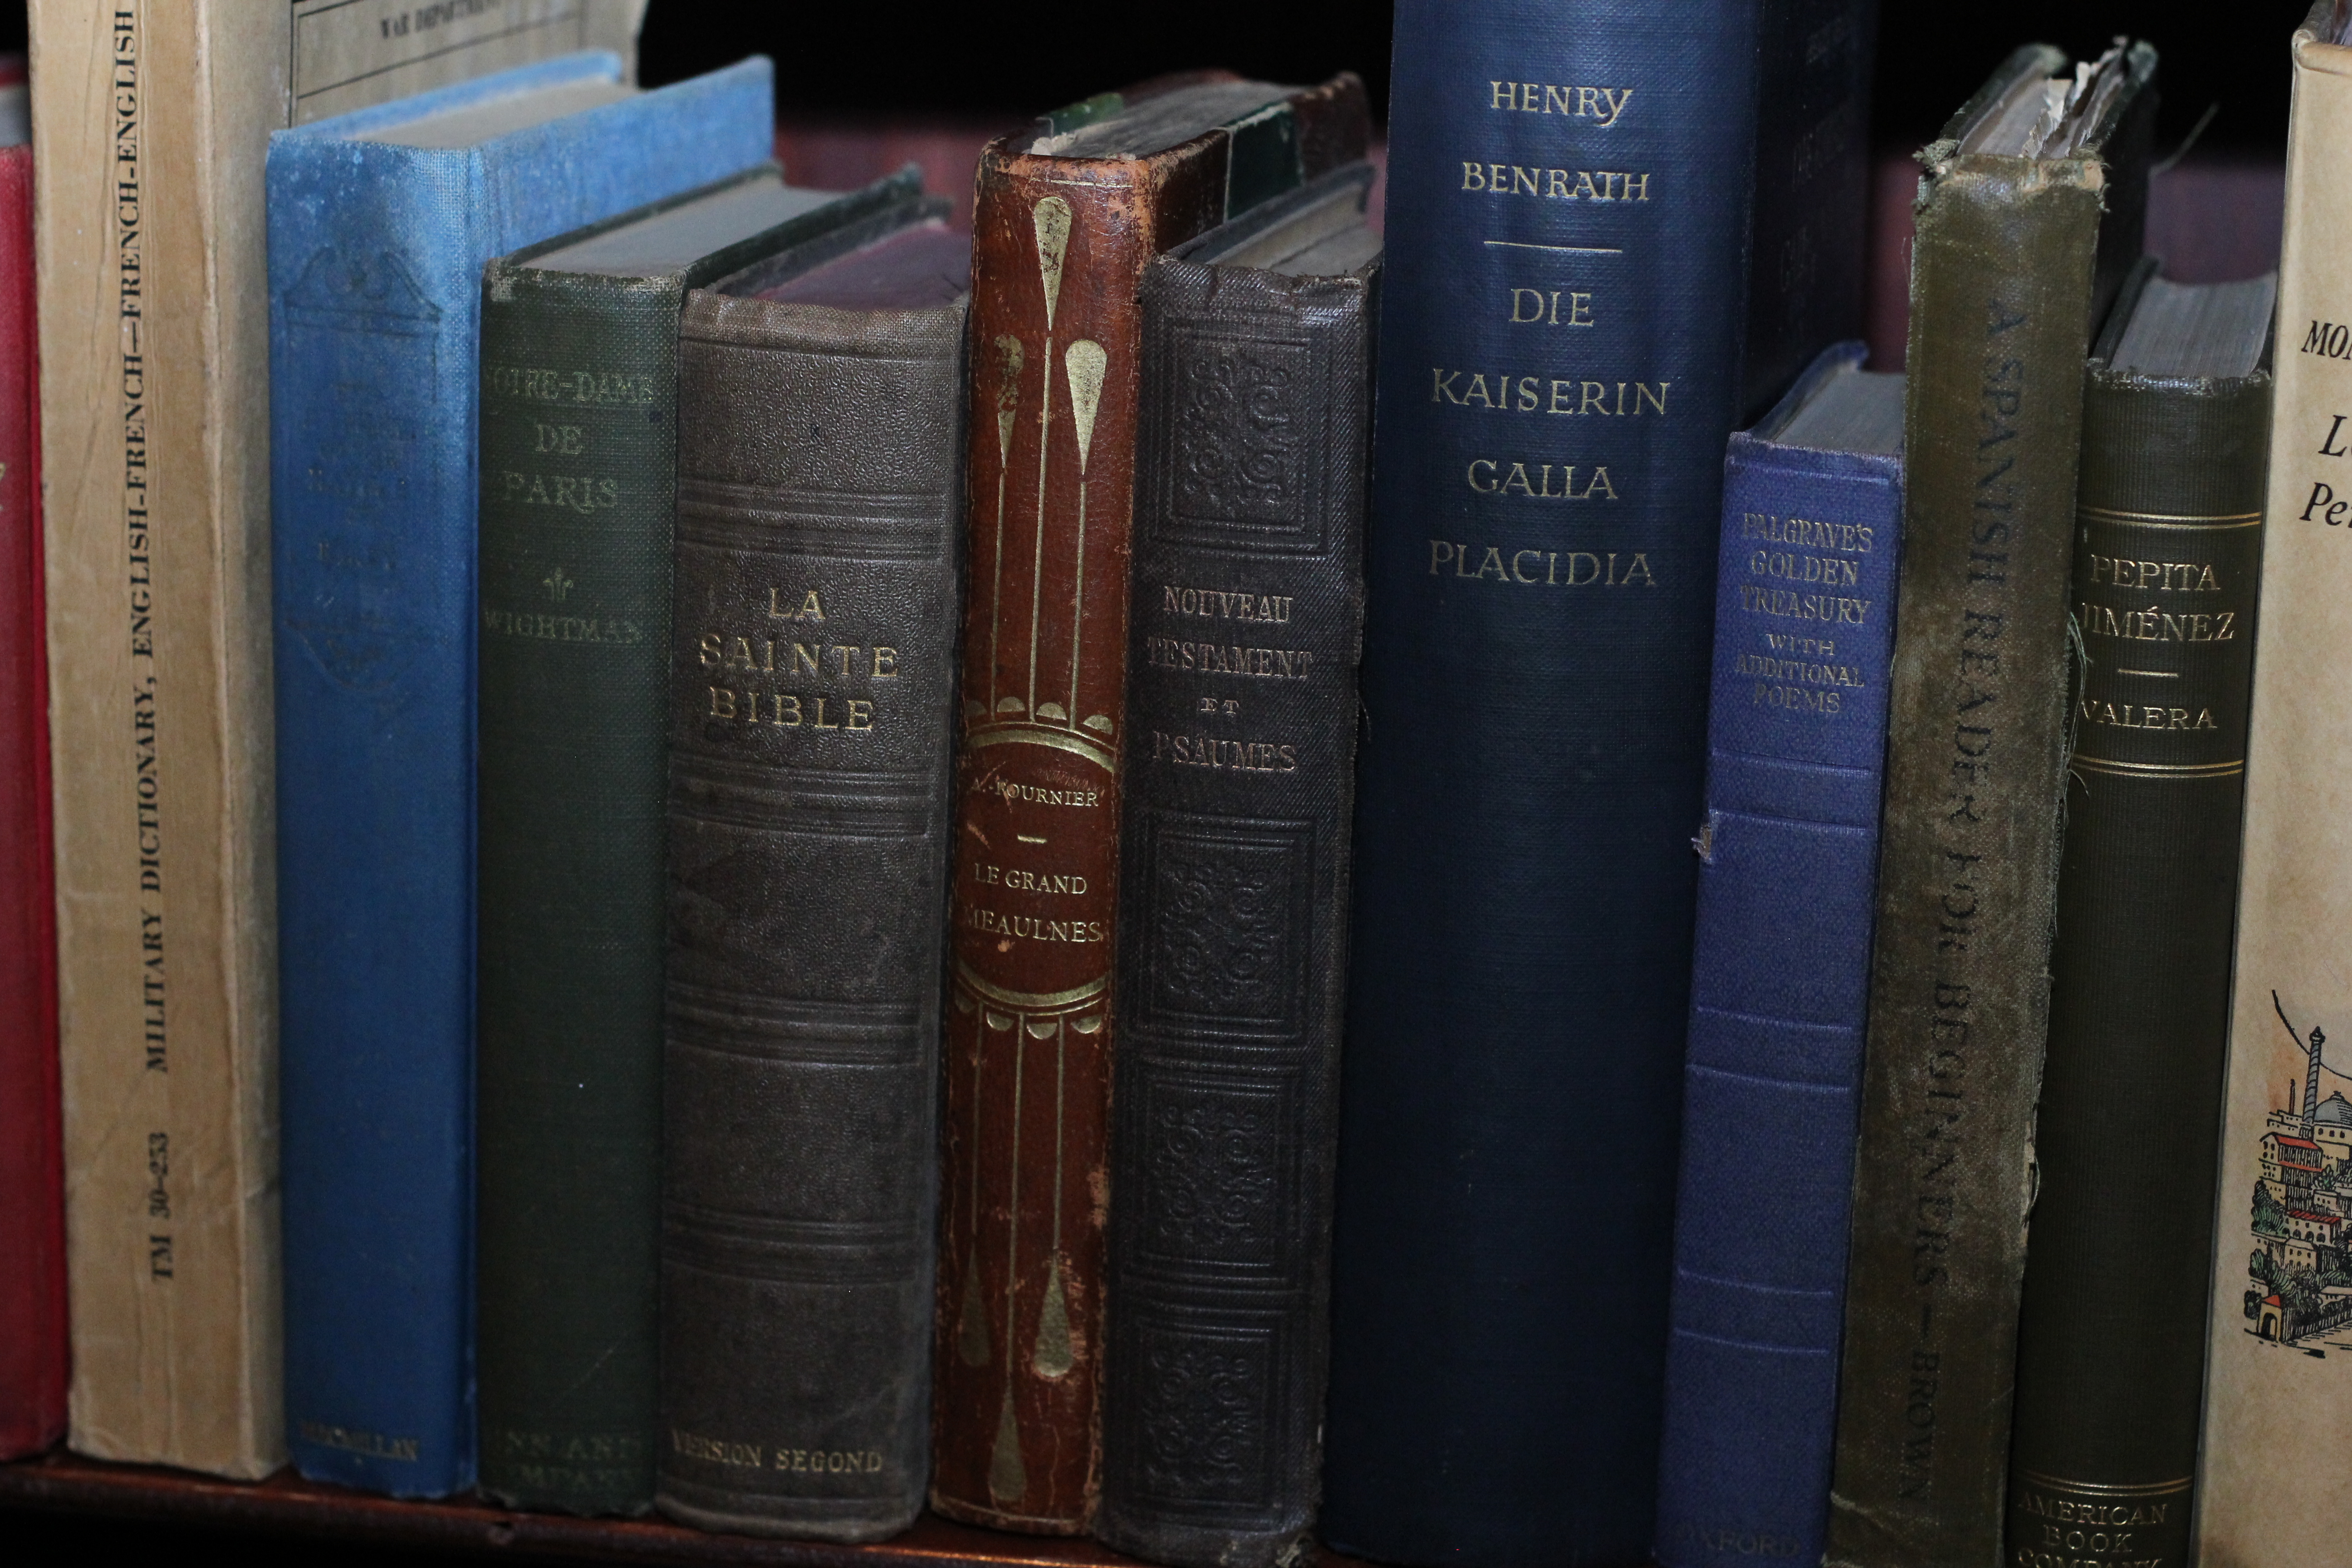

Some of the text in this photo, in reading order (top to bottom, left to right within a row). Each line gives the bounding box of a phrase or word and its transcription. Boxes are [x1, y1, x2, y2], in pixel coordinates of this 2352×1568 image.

[1490, 80, 1633, 127] HENRY
[1461, 161, 1651, 201] BENRATH
[1508, 288, 1594, 327] DIE
[1985, 296, 2028, 337] A
[2301, 320, 2352, 360] MO
[1431, 368, 1671, 415] KAISERIN
[534, 423, 584, 455] DE
[501, 470, 619, 514] PARIS
[1467, 459, 1619, 499] GALLA
[2298, 481, 2352, 529] Pe
[1429, 539, 1656, 586] PLACIDIA
[1751, 550, 1860, 586] GOLDEN
[2090, 554, 2221, 591] PEPITA
[769, 588, 826, 620] LA
[1163, 585, 1294, 623] NOUVEAU
[1739, 585, 1872, 625] TREASURY
[2081, 602, 2235, 642] JIMÉNEZ
[699, 633, 899, 678] SAINTE
[1147, 636, 1313, 679] TESTAMENT
[1766, 633, 1836, 656] WITH
[1735, 652, 1866, 687] ADDITIONAL
[709, 686, 875, 731] BIBLE
[1200, 697, 1240, 714] ET
[1753, 683, 1842, 713] POEMS
[2081, 700, 2219, 730] VALERA
[1152, 730, 1297, 771] PSAUMES
[134, 676, 162, 893] DICTIONARY,
[974, 863, 1088, 895] LE GRAND
[964, 906, 1103, 943] MEAULNES
[142, 909, 168, 1073] MILITARY
[150, 1234, 173, 1283] TM
[1901, 1349, 1940, 1499] BROWN
[775, 1448, 884, 1473] SEGOND
[2018, 1491, 2168, 1526] AMERICAN
[2043, 1524, 2133, 1553] BOOK
